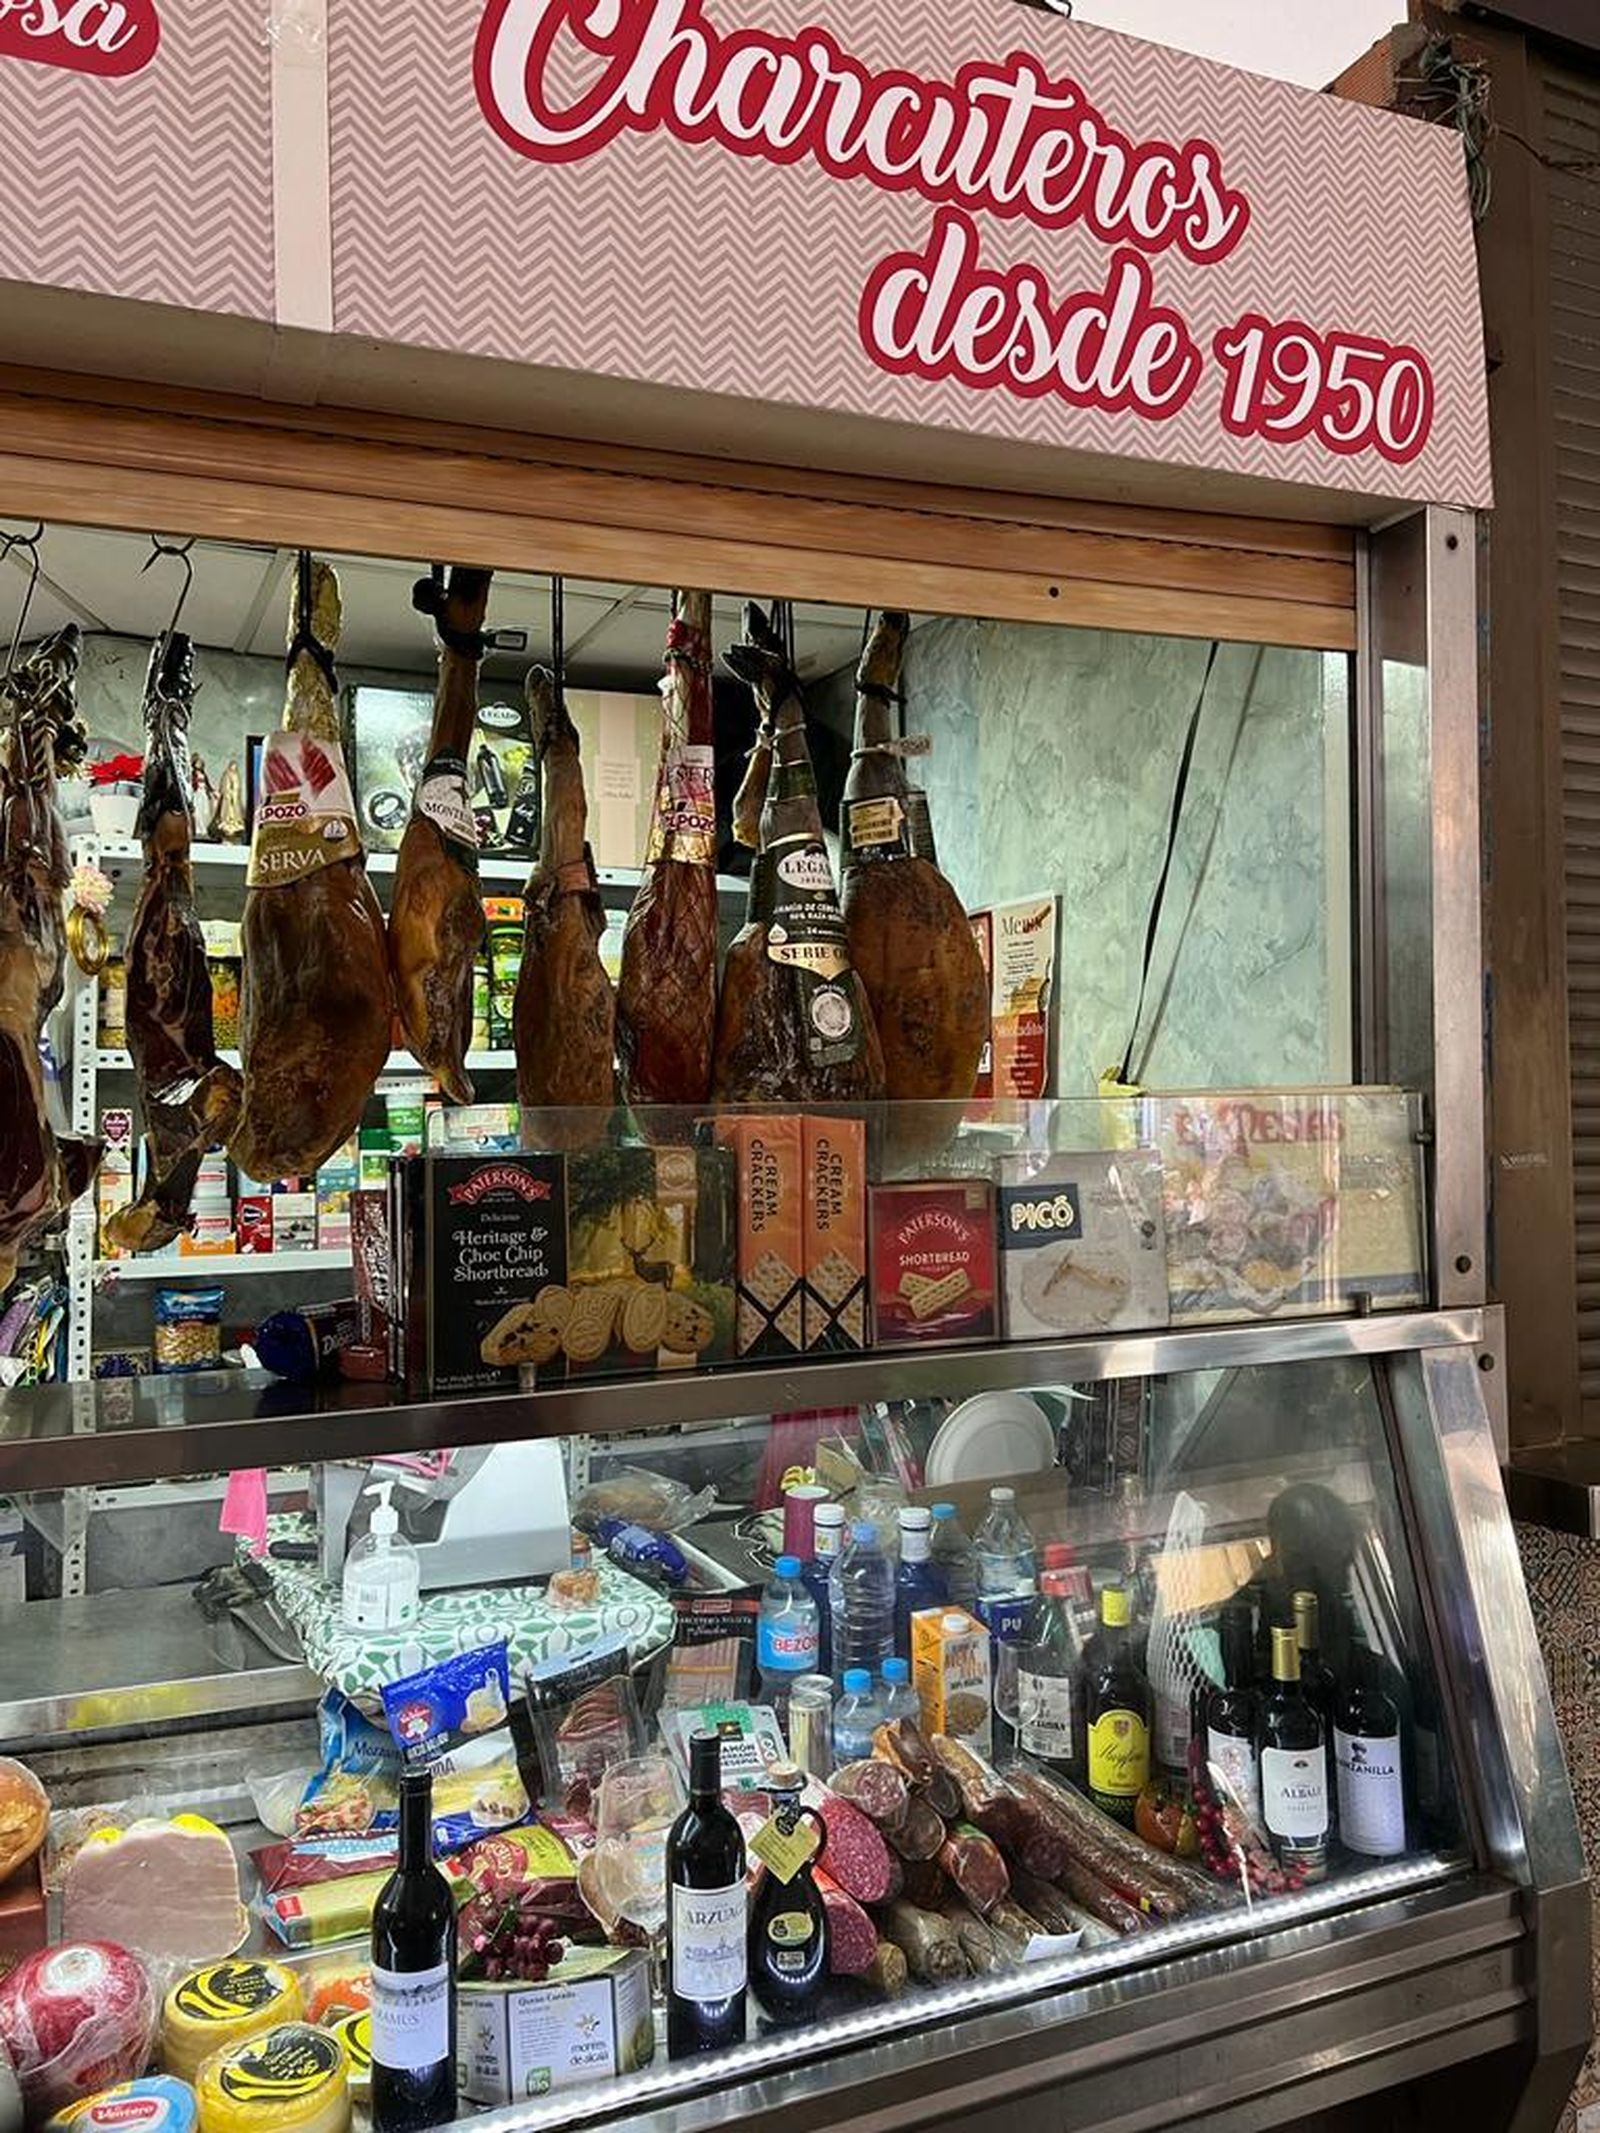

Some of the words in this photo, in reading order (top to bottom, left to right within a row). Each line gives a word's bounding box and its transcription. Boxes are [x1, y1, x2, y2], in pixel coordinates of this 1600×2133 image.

[489, 0, 1241, 252] Charcuteros
[871, 221, 1193, 407] desde
[1224, 327, 1426, 451] 1950
[780, 946, 831, 961] SERIE
[463, 1169, 538, 1201] PATERSON'S
[751, 1139, 765, 1233] CRACKERS
[765, 1154, 778, 1217] CREAM
[816, 1138, 830, 1231] CRACKERS
[830, 1154, 843, 1216] CREAM
[452, 1230, 527, 1246] Heritage
[530, 1226, 549, 1242] &
[898, 1213, 971, 1246] PATERSON'S
[453, 1261, 549, 1282] Shortbread
[459, 1247, 502, 1266] Choc
[505, 1244, 544, 1264] Chip
[899, 1251, 971, 1267] SHORTBREAD
